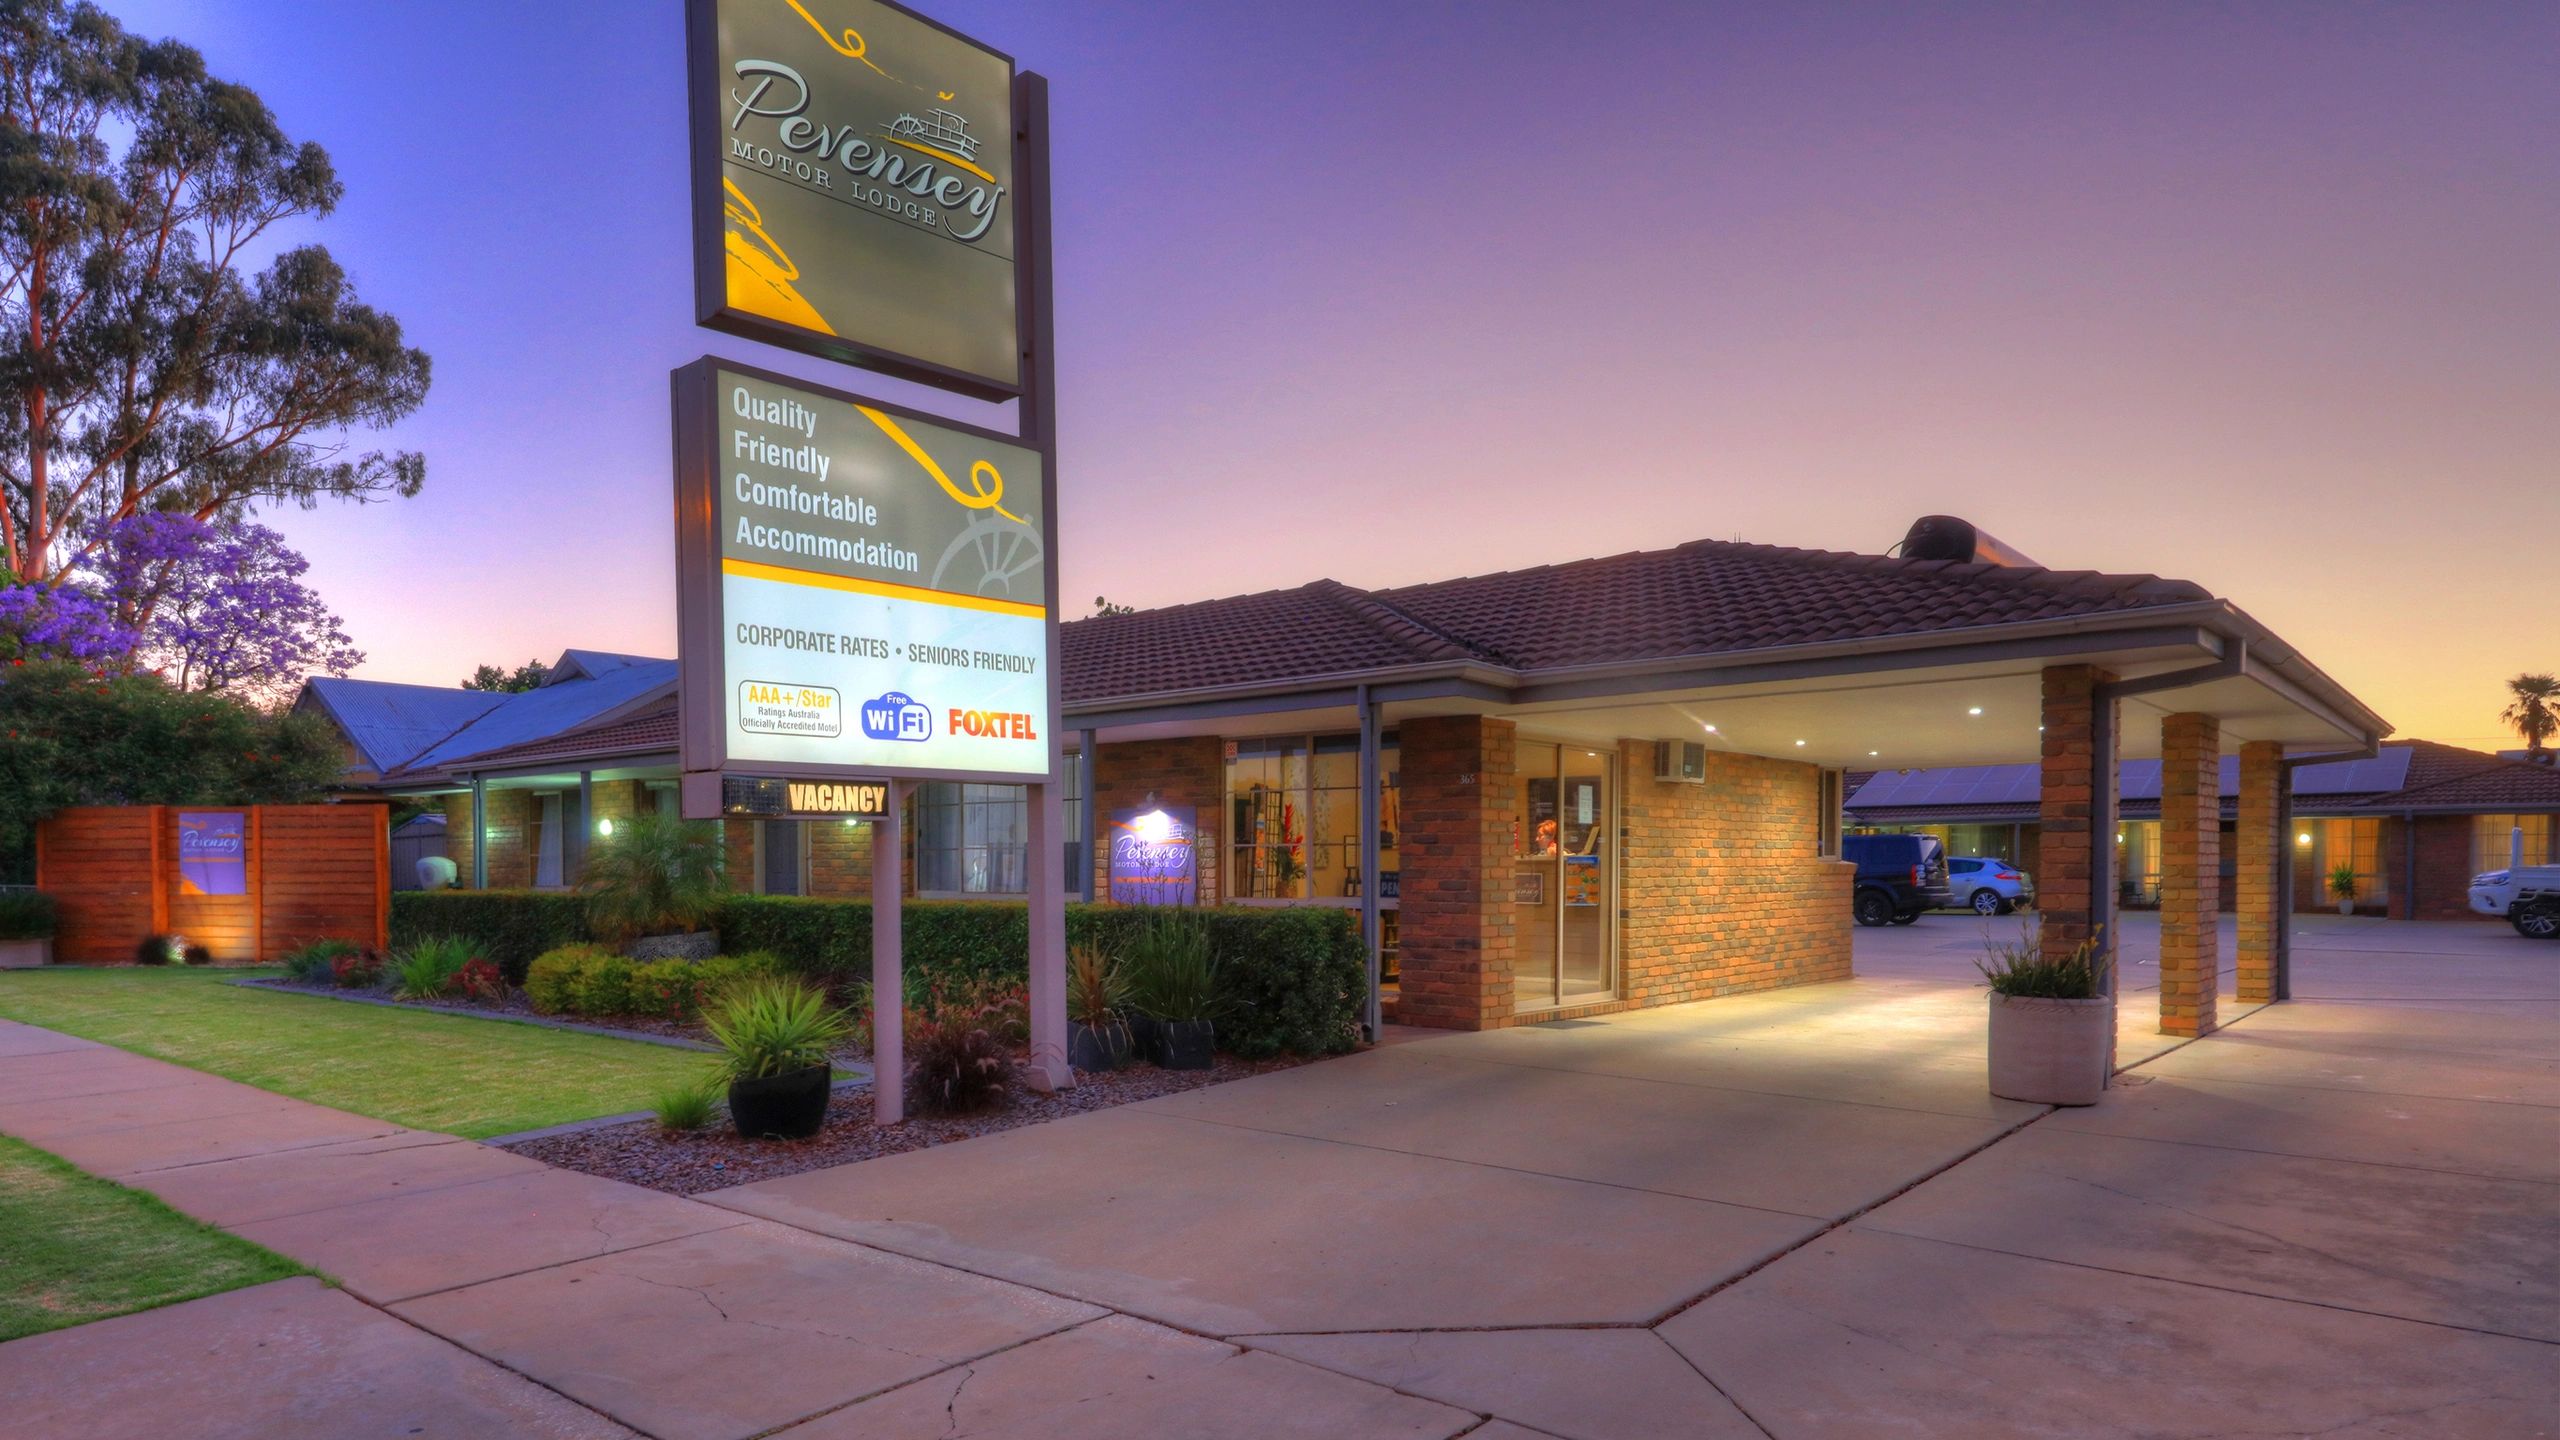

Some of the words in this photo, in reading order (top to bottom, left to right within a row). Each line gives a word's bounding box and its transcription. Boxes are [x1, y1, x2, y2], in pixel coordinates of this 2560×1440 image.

[731, 58, 1006, 241] Pevensey
[731, 137, 832, 190] MOTOR
[851, 182, 937, 226] LODGE
[733, 387, 817, 438] Quality
[734, 429, 830, 482] Friendly
[735, 473, 877, 526] Comfortable
[736, 516, 918, 572] Accommodation
[737, 623, 836, 654] CORPORATE
[841, 635, 889, 659] RATES
[909, 643, 969, 668] SENIORS
[974, 651, 1036, 674] FRIENDLY
[758, 706, 786, 718] Ratings
[788, 709, 820, 719] Australia
[887, 694, 907, 705] Free
[742, 717, 776, 730] Officially
[777, 720, 816, 731] Accredited
[817, 722, 838, 732] Motel
[949, 708, 1037, 740] FOXTEL
[788, 783, 885, 812] VACANCY
[1115, 834, 1192, 869] Pevensey
[1381, 881, 1399, 896] PEN
